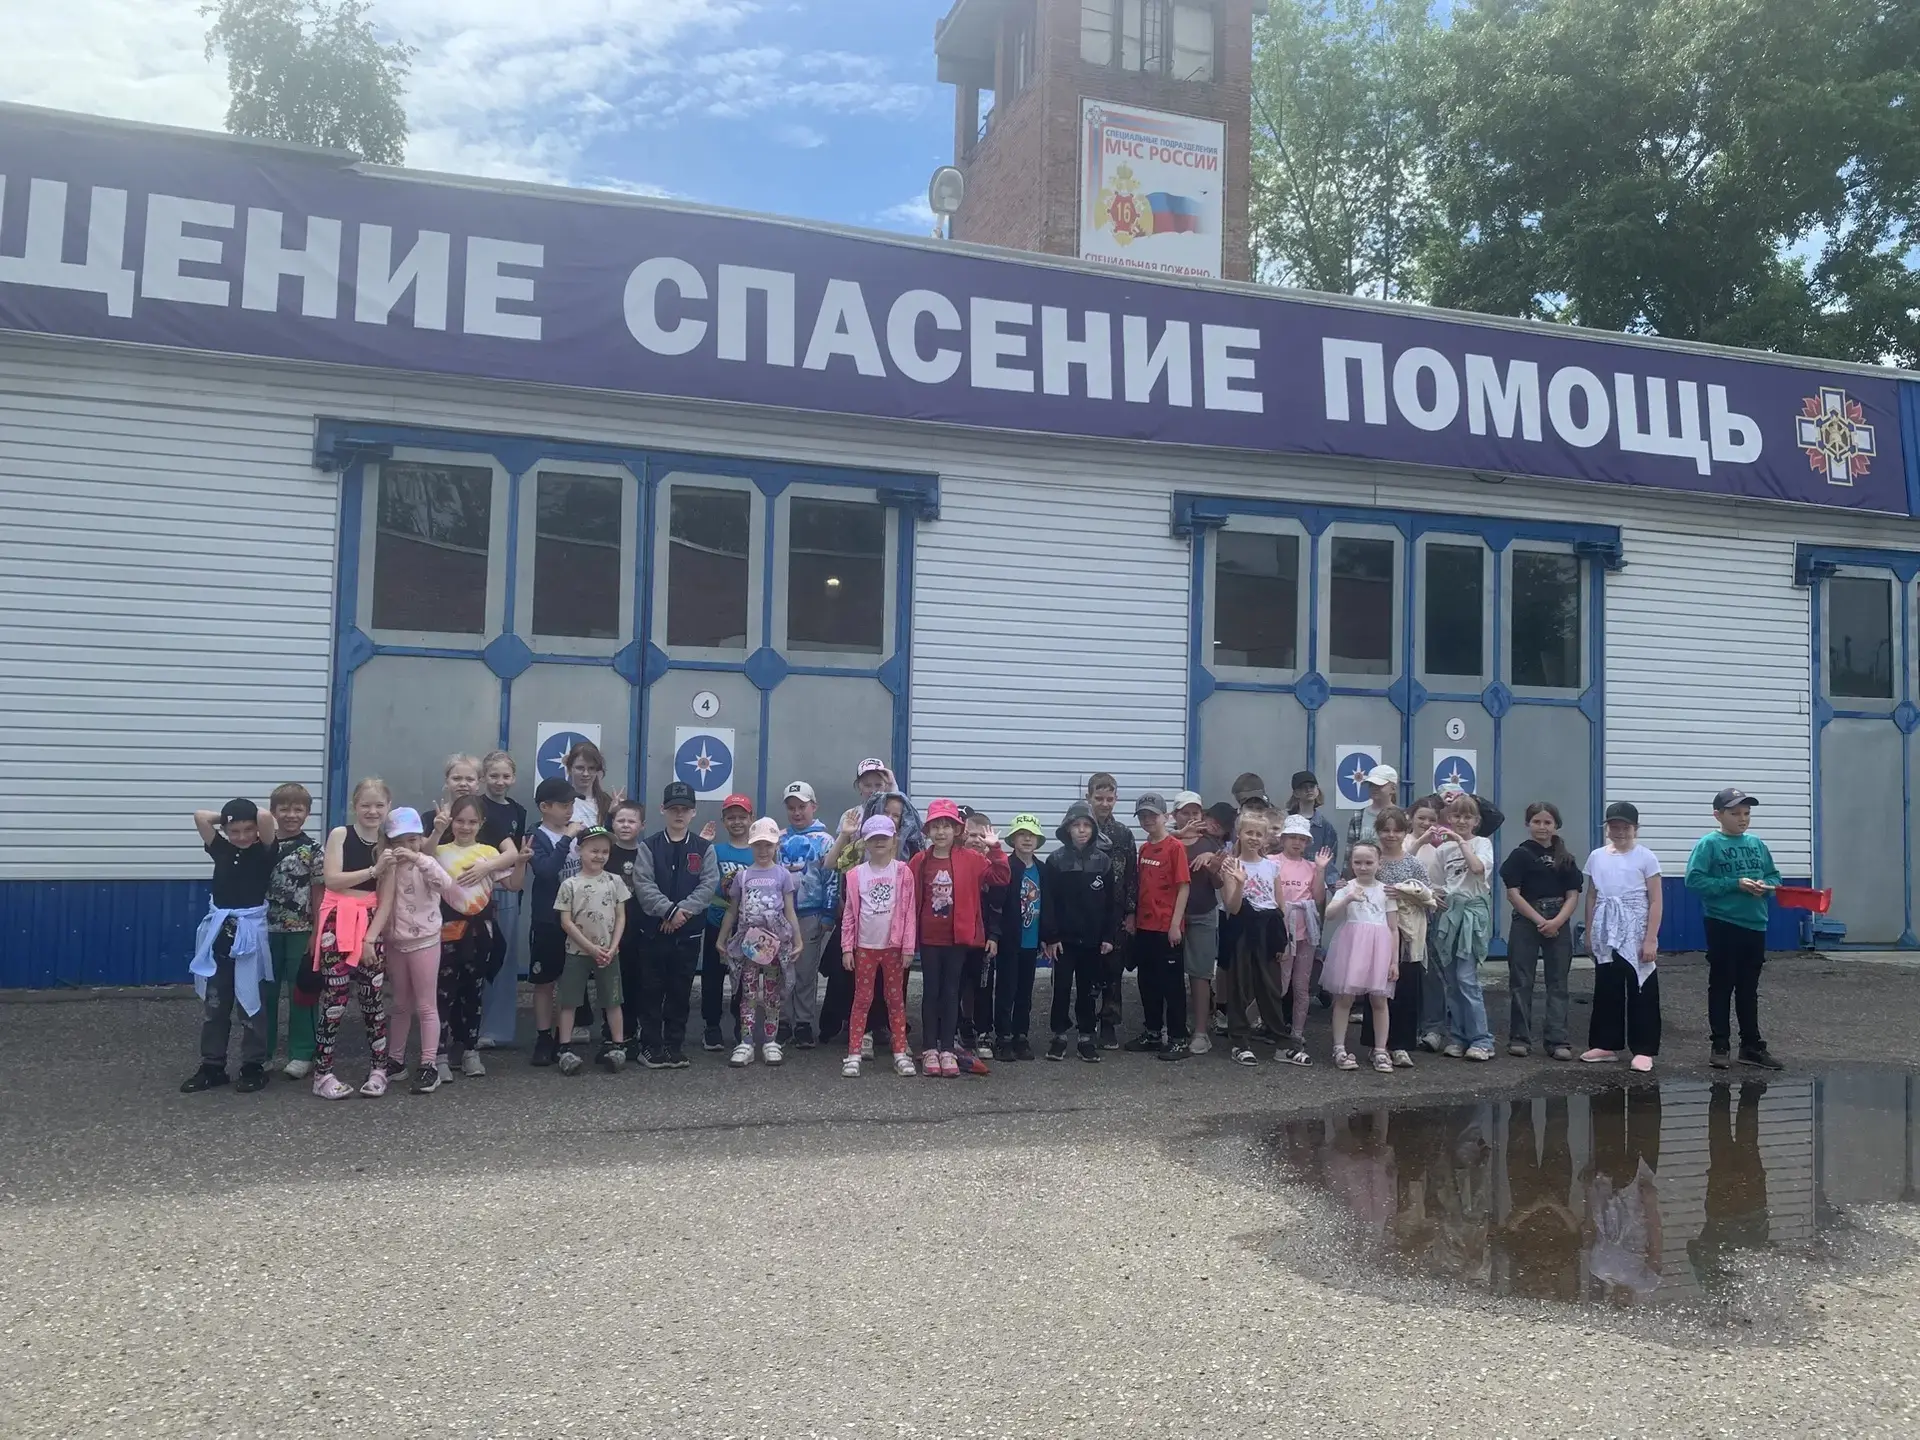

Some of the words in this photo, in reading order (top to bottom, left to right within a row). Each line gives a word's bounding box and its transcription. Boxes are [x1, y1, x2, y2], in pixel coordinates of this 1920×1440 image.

[1105, 129, 1159, 145] СПЕЦИАЛЬНЫЕ
[1160, 138, 1218, 155] ПОДРАЗДЕЛЕНИЯ
[1105, 137, 1144, 159] МЧС
[1149, 145, 1217, 171] РОССИИ
[1117, 202, 1131, 223] 16
[623, 257, 1263, 413] СПАСЕНИЕ
[1322, 337, 1763, 475] ПОМОЩЬ
[701, 699, 711, 711] 4
[1452, 724, 1460, 735] 5
[227, 815, 233, 824] P
[1721, 846, 1738, 860] NO
[1738, 846, 1760, 859] TIME
[1718, 862, 1732, 873] TO
[1735, 860, 1746, 871] BE
